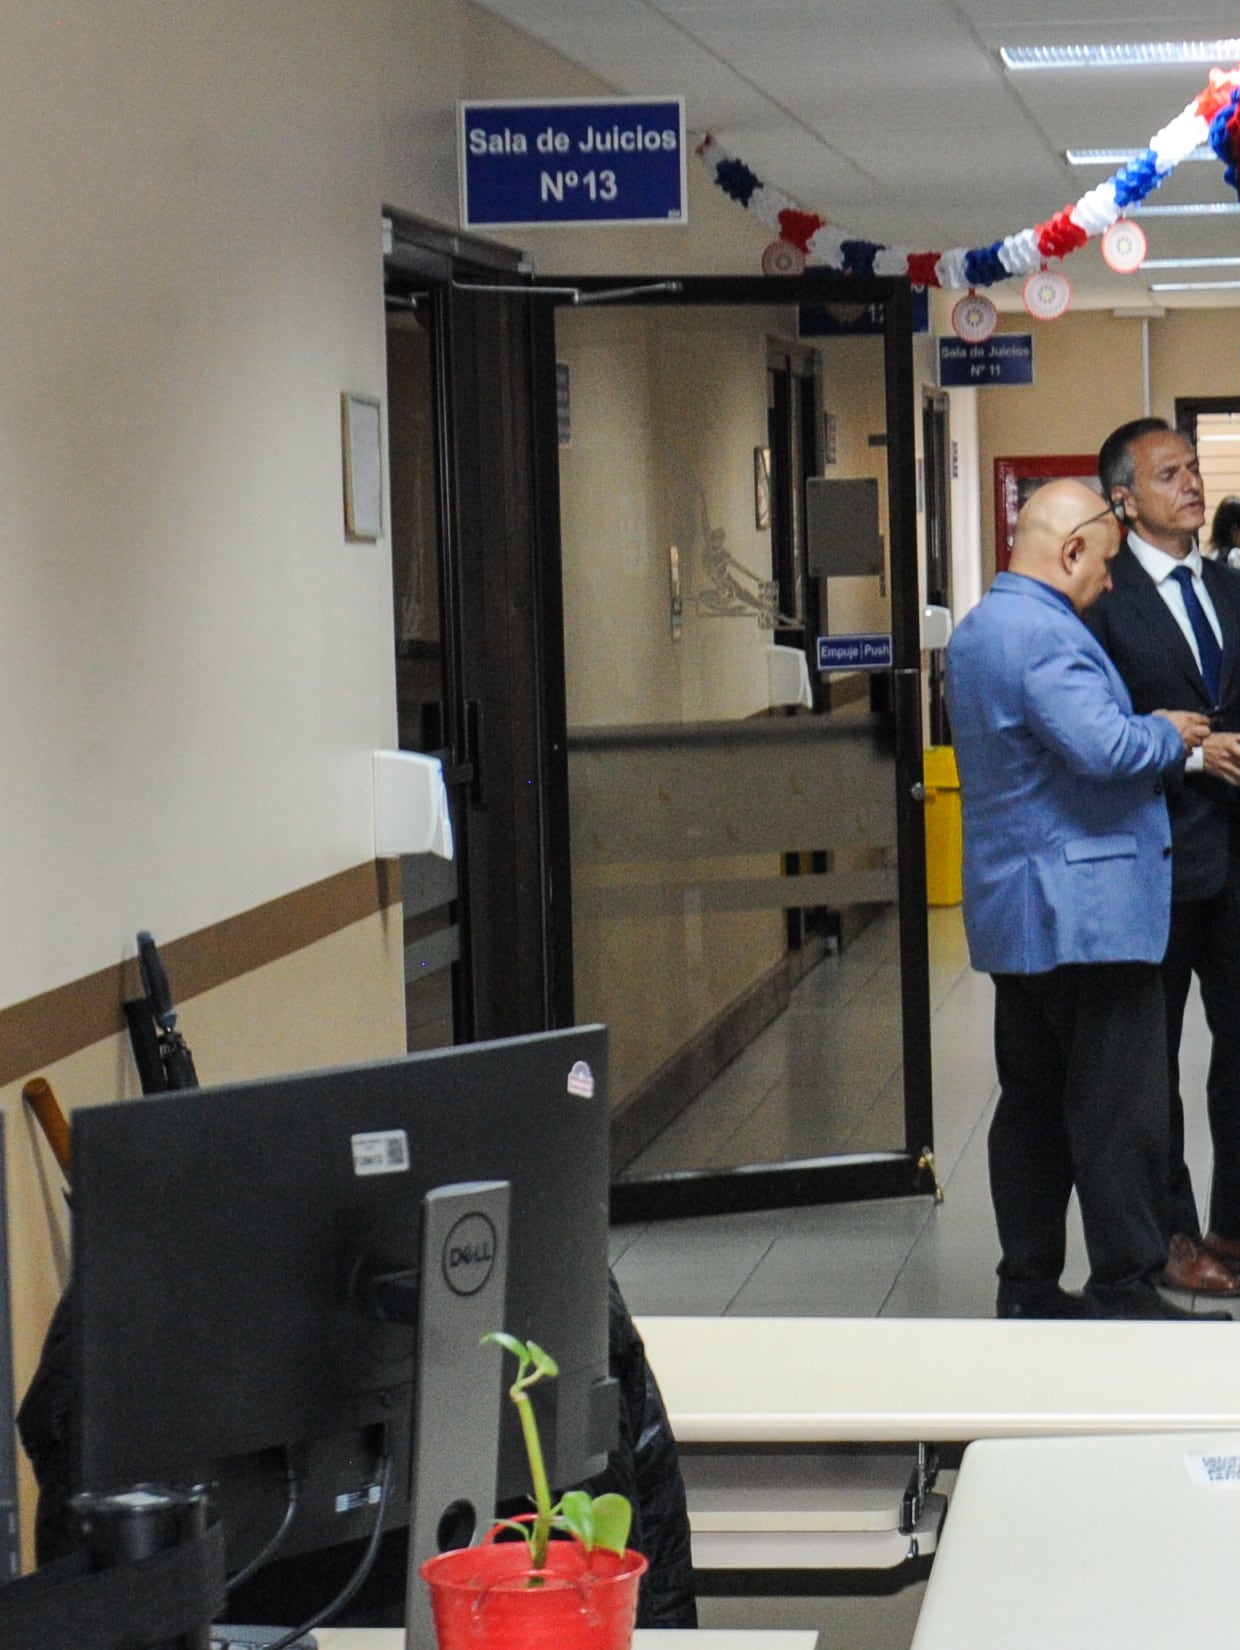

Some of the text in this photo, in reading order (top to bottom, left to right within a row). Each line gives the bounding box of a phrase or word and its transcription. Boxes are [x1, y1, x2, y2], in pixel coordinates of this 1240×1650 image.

[469, 125, 677, 154] Sala de Juicios
[941, 344, 1030, 359] Sala de Juicios
[989, 364, 1001, 377] 11
[821, 643, 889, 661] Empuje Push
[449, 1241, 491, 1268] DELL
